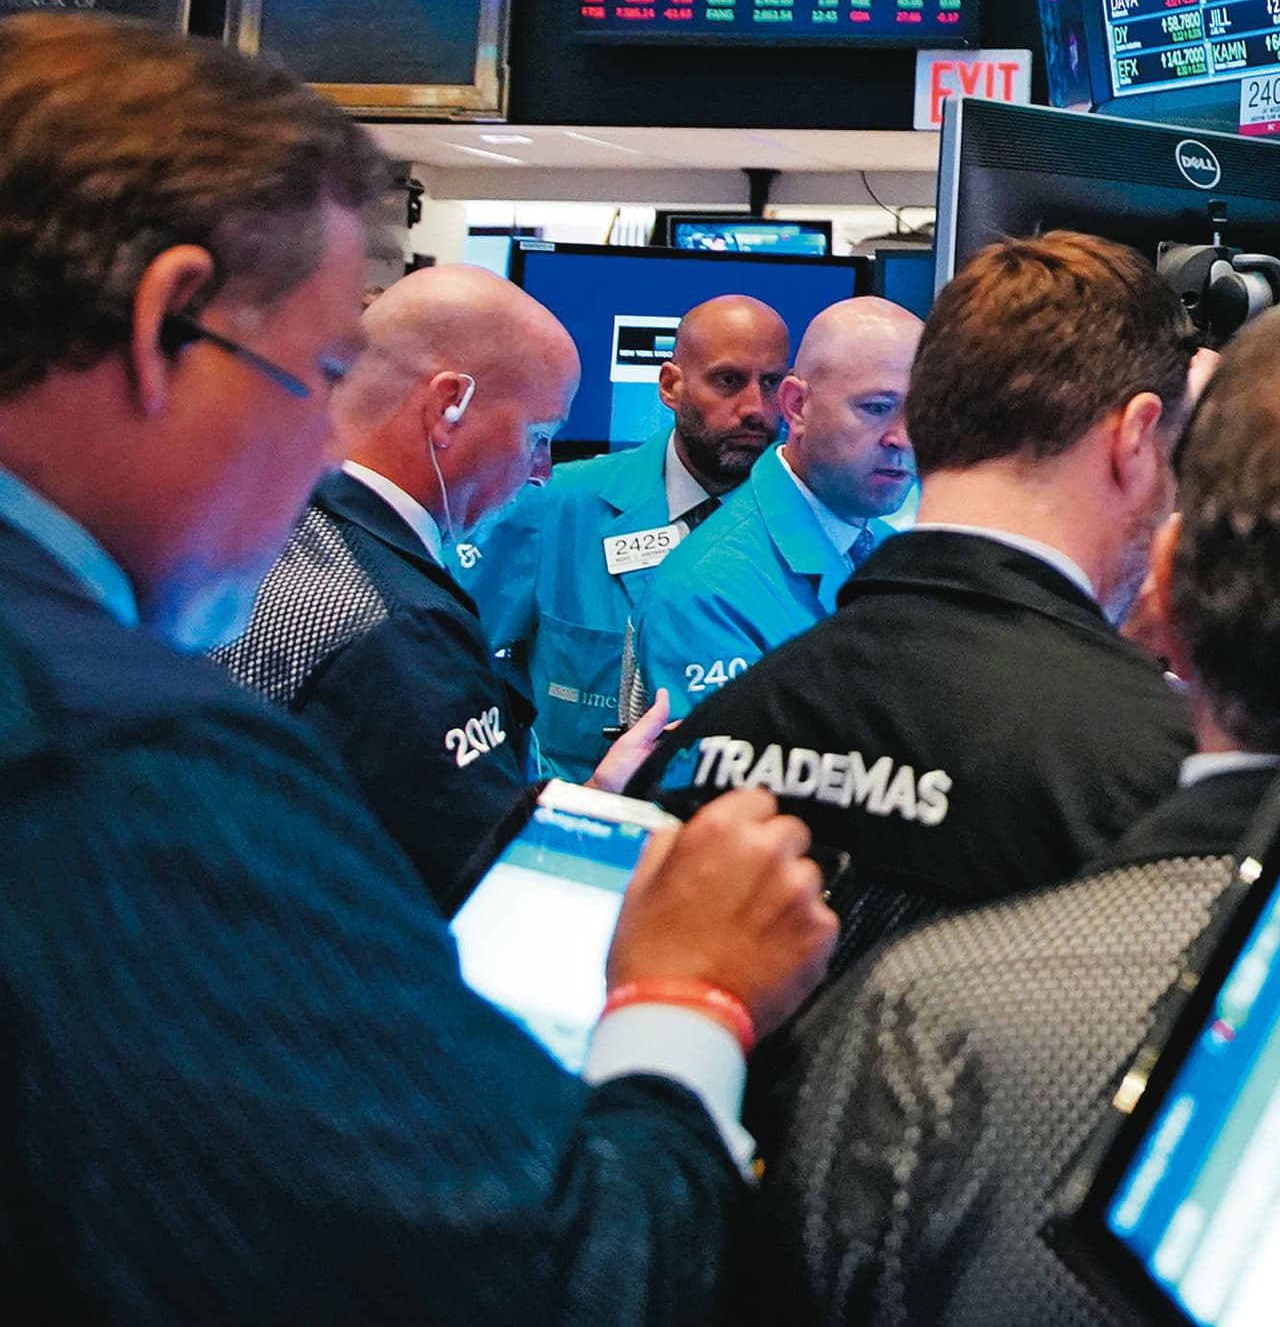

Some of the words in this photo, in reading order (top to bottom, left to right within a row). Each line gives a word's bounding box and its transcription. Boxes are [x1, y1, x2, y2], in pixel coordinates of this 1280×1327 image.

[929, 61, 1019, 126] EXIT
[1181, 155, 1216, 171] DELL
[615, 531, 670, 556] 2425
[445, 706, 506, 768] 2012
